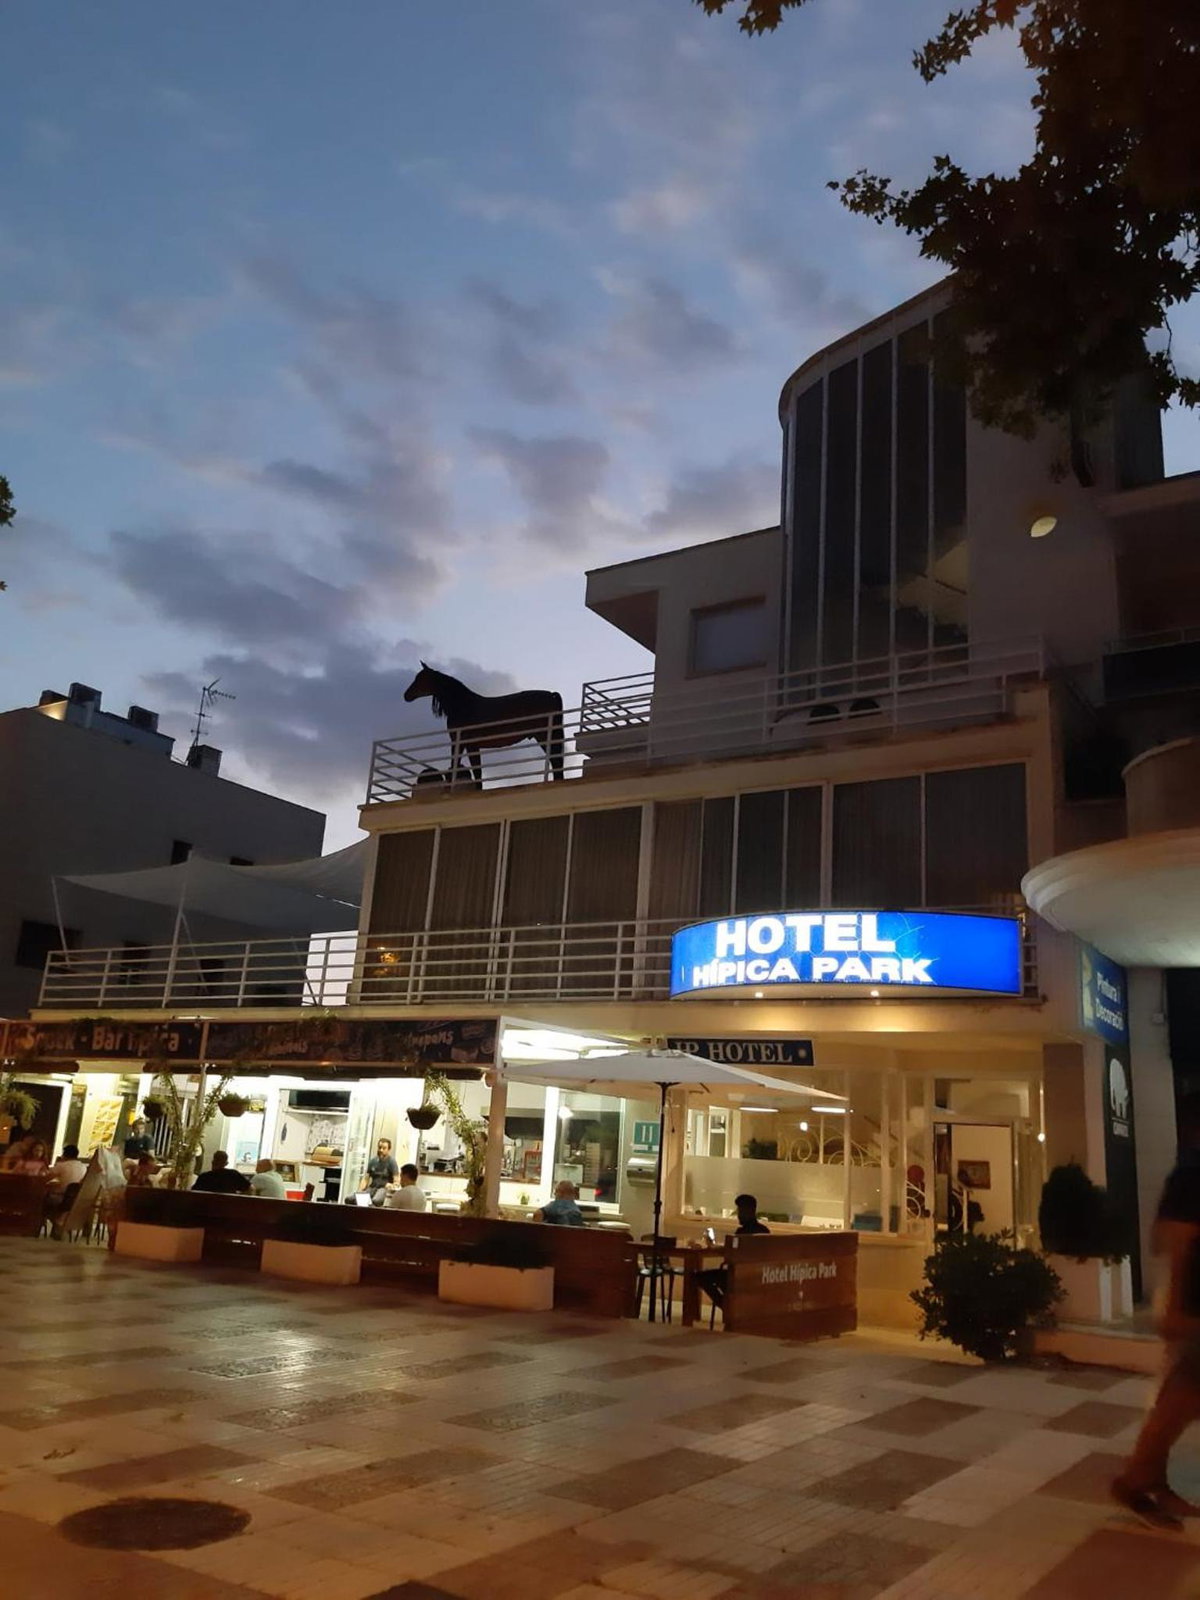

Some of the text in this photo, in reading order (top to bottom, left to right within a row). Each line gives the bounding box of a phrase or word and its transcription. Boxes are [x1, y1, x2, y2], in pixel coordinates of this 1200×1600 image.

[715, 913, 897, 957] HOTEL
[692, 955, 934, 987] HÍPICA PARK
[91, 1025, 124, 1052] Bar
[706, 1041, 793, 1063] HOTEL
[761, 1265, 788, 1284] Hotel
[818, 1261, 837, 1279] Park
